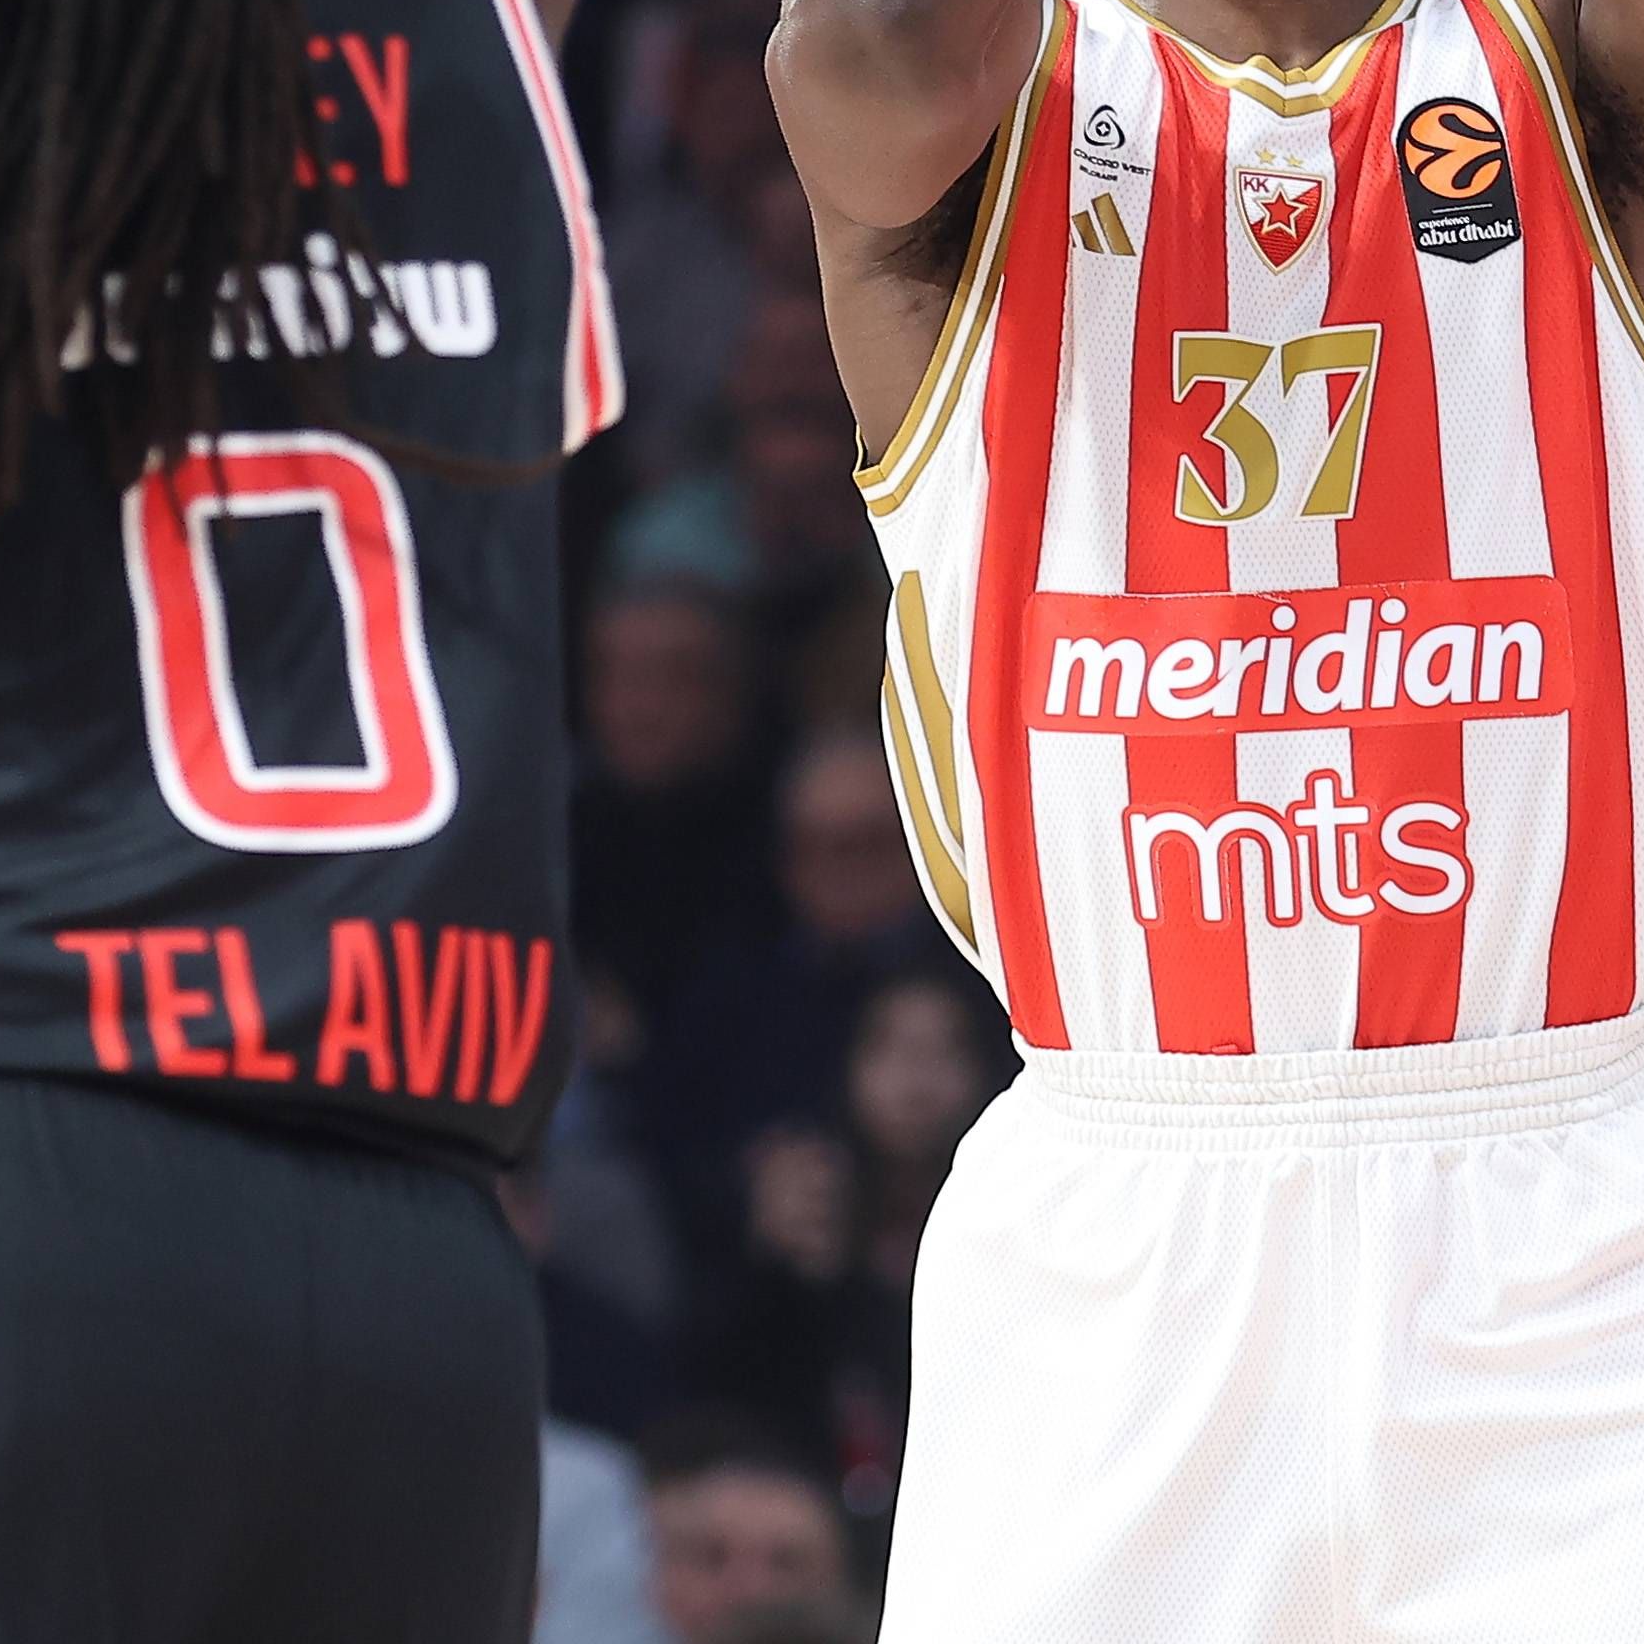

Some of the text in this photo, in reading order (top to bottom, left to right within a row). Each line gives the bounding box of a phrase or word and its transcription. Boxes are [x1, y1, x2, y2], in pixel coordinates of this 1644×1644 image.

[1243, 176, 1270, 194] KK
[1418, 216, 1471, 230] experience
[1420, 219, 1515, 246] abu dhabi
[1169, 323, 1382, 527] 37
[123, 432, 458, 853] 0
[1045, 597, 1544, 720] meridian
[1128, 771, 1466, 923] mts
[55, 920, 553, 1106] TEL AVIV
